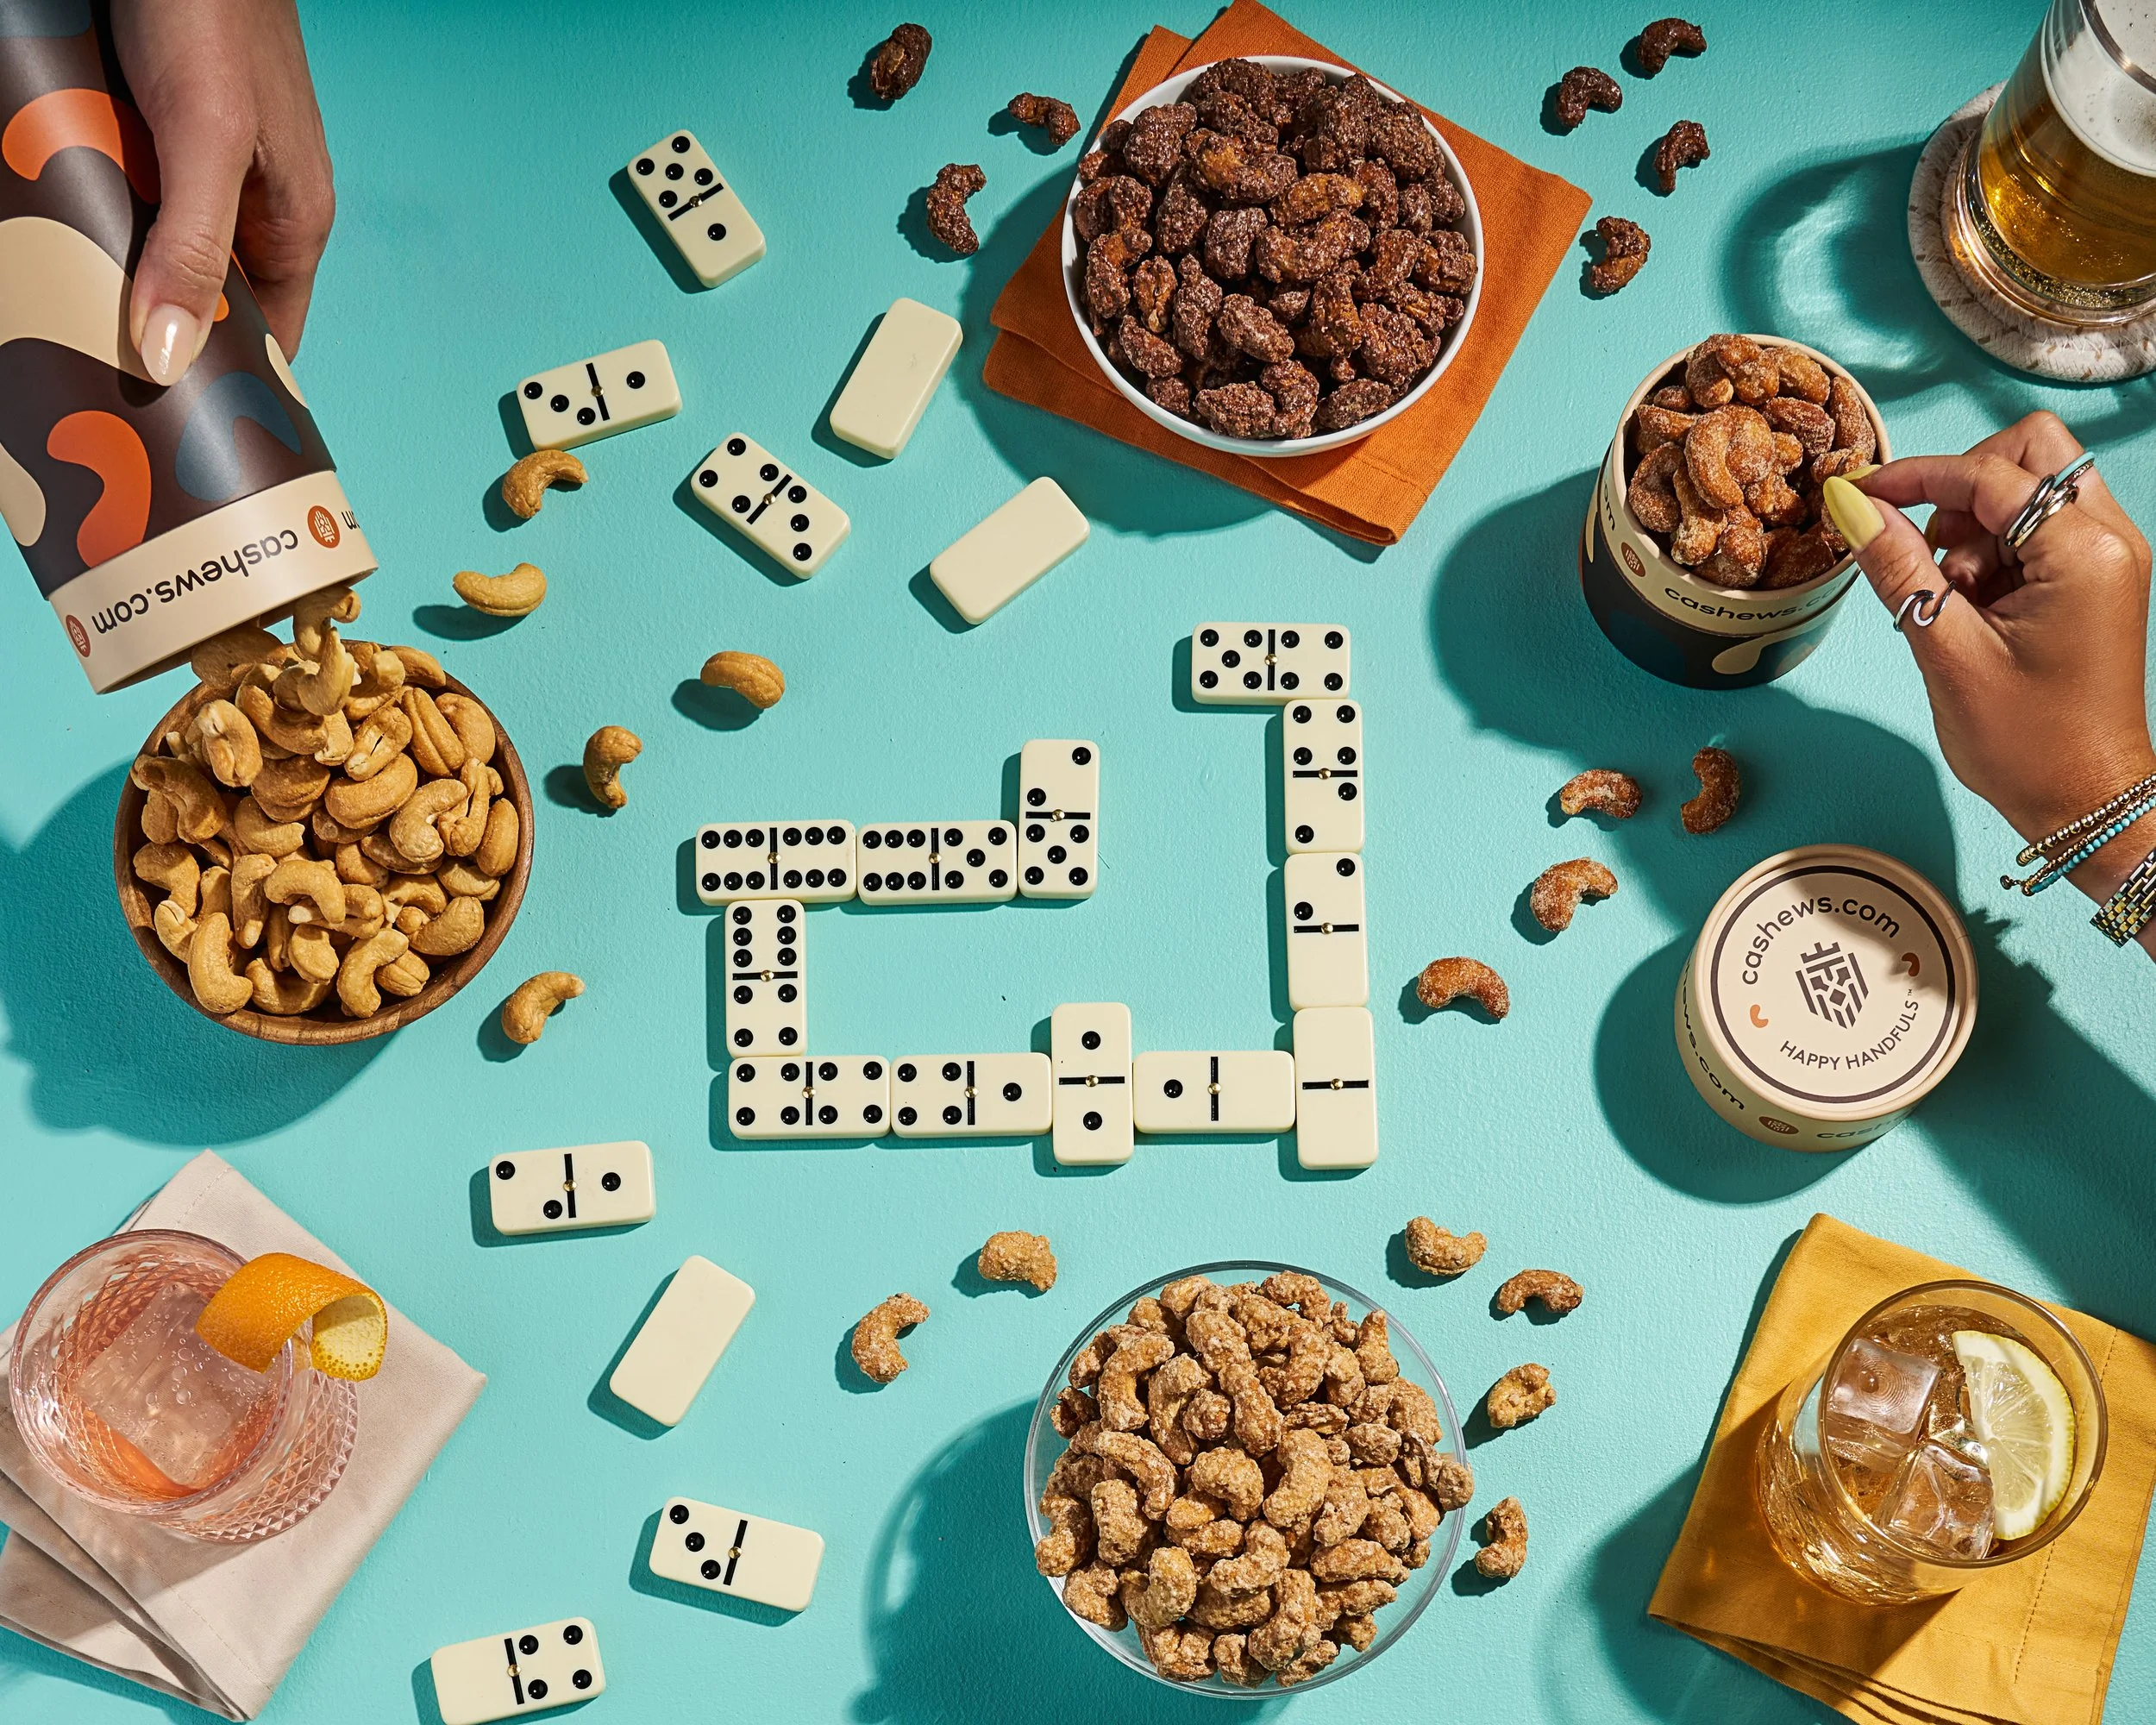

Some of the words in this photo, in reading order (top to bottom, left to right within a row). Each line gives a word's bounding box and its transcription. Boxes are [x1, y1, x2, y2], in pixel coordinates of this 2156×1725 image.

[91, 530, 298, 634] cashews.com
[1742, 897, 1900, 985] cashews.com
[1780, 1040, 1840, 1070] HAPPY
